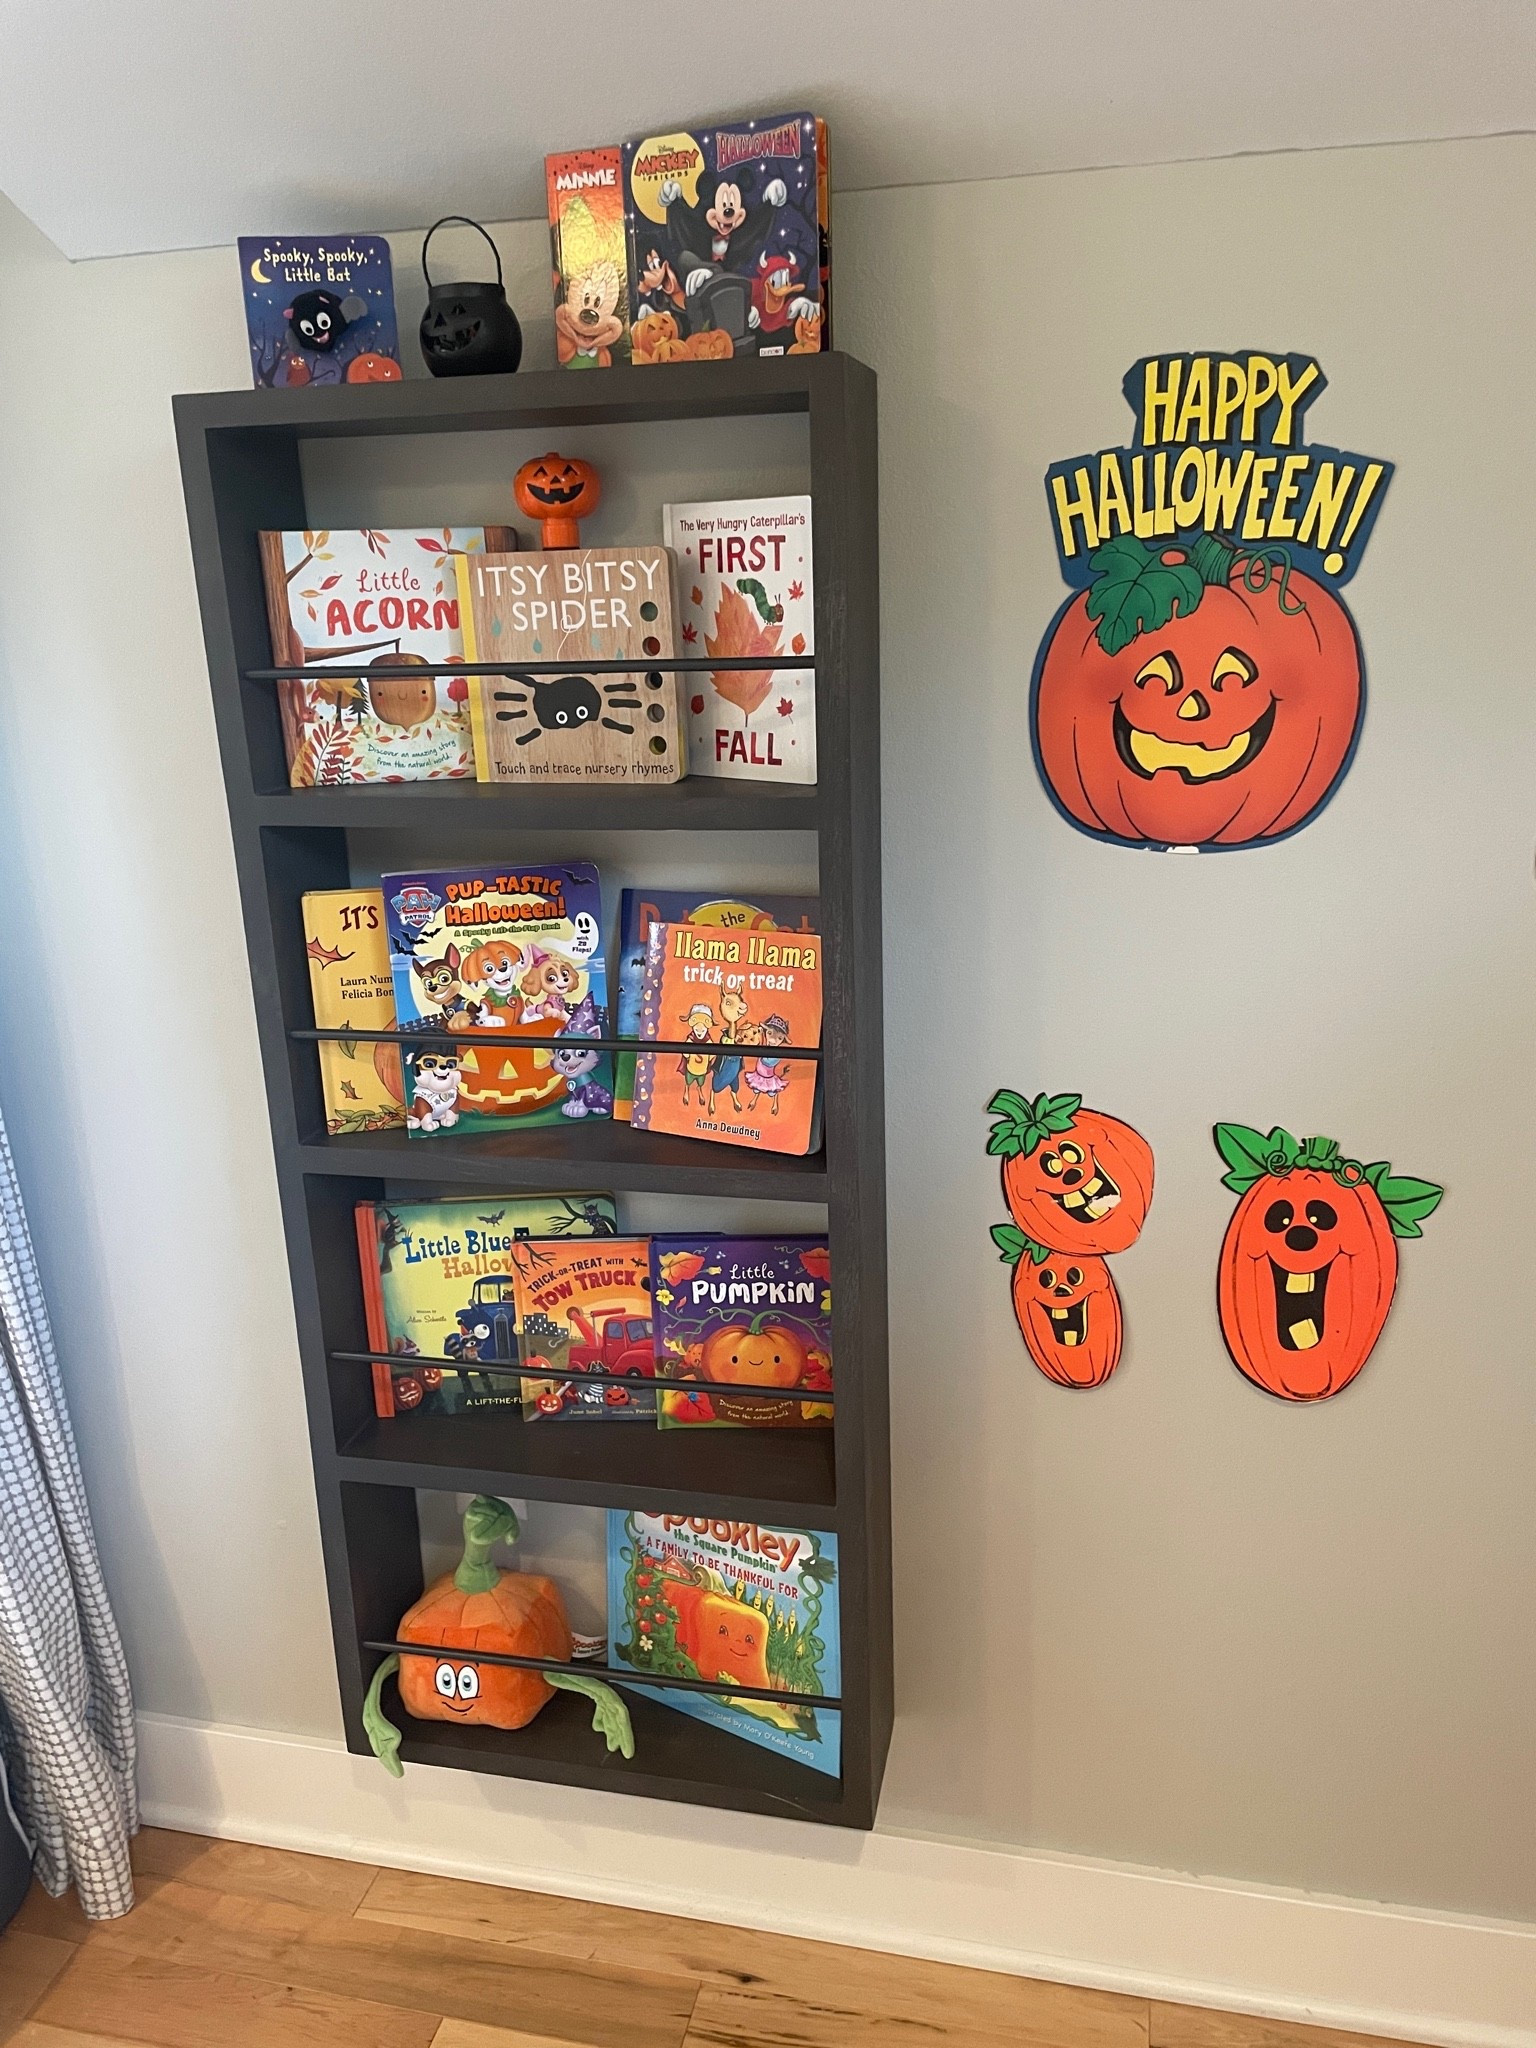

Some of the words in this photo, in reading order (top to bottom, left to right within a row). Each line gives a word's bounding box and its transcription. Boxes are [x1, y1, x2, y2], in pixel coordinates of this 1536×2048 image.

[716, 119, 801, 172] HALLOWEEN
[634, 148, 700, 177] MICKEY
[648, 170, 690, 183] FRIENDS
[556, 168, 616, 192] MINNIE
[263, 247, 314, 267] Spooky,
[318, 247, 368, 265] Spooky,
[284, 268, 322, 283] Little
[327, 267, 351, 283] Bat
[1142, 355, 1320, 448] HAPPY
[680, 519, 695, 532] The
[696, 518, 715, 533] Very
[717, 516, 748, 532] Hungry
[750, 513, 806, 530] Caterpillar's
[1051, 445, 1385, 575] HALLOWEEN!
[698, 534, 787, 575] FIRST
[356, 567, 421, 593] Little
[477, 563, 549, 598] ITSY
[563, 558, 661, 595] BITSY
[326, 596, 460, 637] ACORN
[511, 597, 633, 633] SPIDER
[367, 743, 399, 757] Discover
[438, 739, 457, 752] story
[714, 728, 783, 767] FALL
[376, 757, 392, 767] from
[394, 761, 406, 769] the
[408, 758, 431, 769] natural
[494, 761, 526, 776] Touch
[529, 761, 550, 775] and
[552, 763, 582, 776] trace
[585, 763, 628, 778] nursery
[631, 760, 674, 777] rhymes
[445, 875, 562, 903] PUP-TASTIC
[390, 893, 442, 914] PAW
[404, 913, 432, 922] PATROL
[444, 896, 568, 928] Halloween!
[339, 904, 380, 932] IT'S
[541, 922, 561, 932] Book
[720, 911, 746, 929] the
[674, 930, 741, 964] llama
[746, 936, 817, 971] llama
[340, 974, 368, 988] Laura
[369, 973, 393, 986] Num
[683, 962, 723, 986] trick
[726, 973, 746, 989] or
[749, 971, 795, 992] treat
[341, 987, 374, 1000] Felicia
[375, 987, 395, 999] Bon
[695, 1119, 718, 1132] Anna
[720, 1122, 761, 1141] Dewdney
[401, 1234, 462, 1264] Little
[465, 1229, 511, 1256] Blue
[527, 1257, 603, 1294] TRICK-OR-TREAT
[605, 1258, 624, 1266] WITH
[729, 1262, 776, 1281] Little
[531, 1279, 574, 1313] TOW
[573, 1268, 638, 1293] TRUCK
[466, 1398, 473, 1406] A
[643, 1510, 801, 1573] pookley
[673, 1528, 690, 1544] the
[693, 1534, 728, 1557] Square
[730, 1546, 777, 1574] Pumpkin
[646, 1536, 653, 1548] A
[692, 1551, 705, 1566] TO
[708, 1559, 721, 1572] BE
[723, 1564, 776, 1592] THANKFUL
[778, 1581, 799, 1600] FOR
